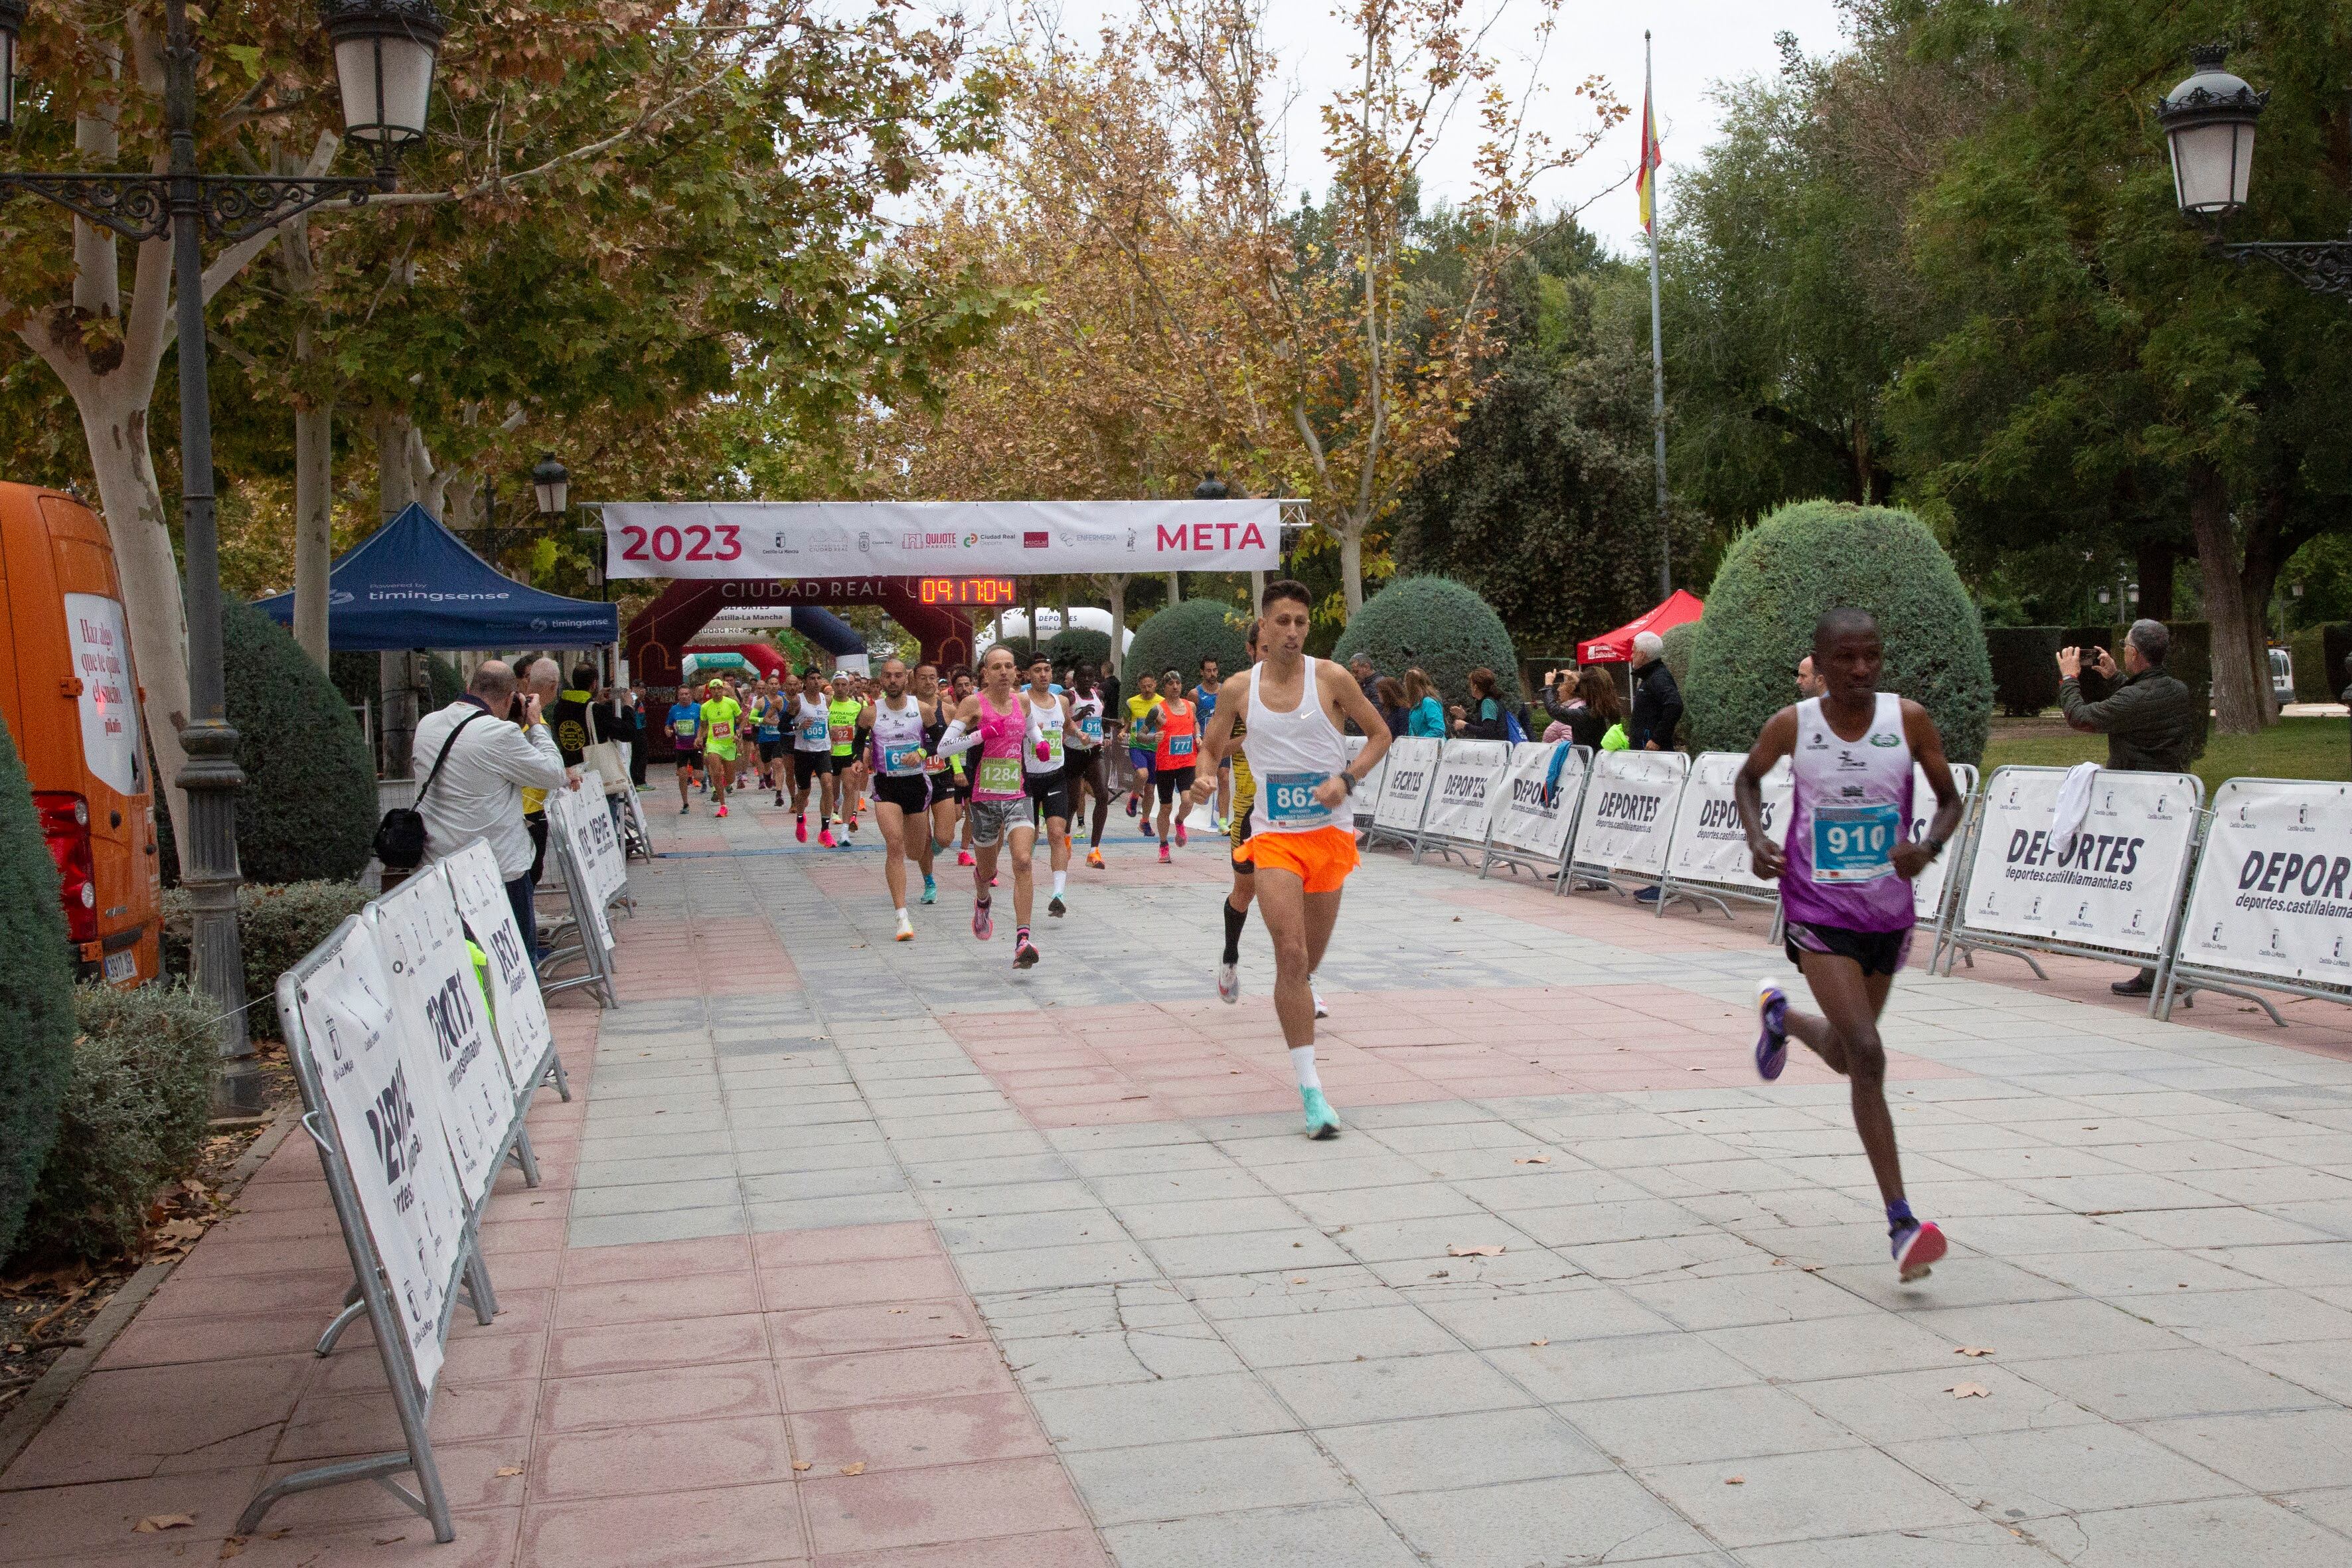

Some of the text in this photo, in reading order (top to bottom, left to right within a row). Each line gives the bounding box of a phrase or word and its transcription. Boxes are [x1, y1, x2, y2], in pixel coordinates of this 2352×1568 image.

[621, 524, 740, 562] 2023
[925, 533, 956, 545] QUIJOTE
[1157, 522, 1266, 552] META
[369, 591, 509, 601] timingsense
[722, 582, 887, 598] CIUDAD REAL
[922, 580, 1012, 602] 09:17:04
[80, 619, 98, 644] Haz
[552, 618, 609, 628] timingsense
[82, 653, 98, 676] que
[715, 726, 728, 734] 206
[807, 727, 823, 736] 605
[1086, 722, 1101, 732] 911
[1174, 741, 1190, 750] 777
[983, 767, 1020, 782] 1284
[1277, 786, 1320, 808] 862
[1444, 774, 1488, 799] DEPORTES
[1598, 792, 1661, 822] DEPORTES
[1827, 824, 1886, 854] 910
[2238, 850, 2352, 899] DEPOR
